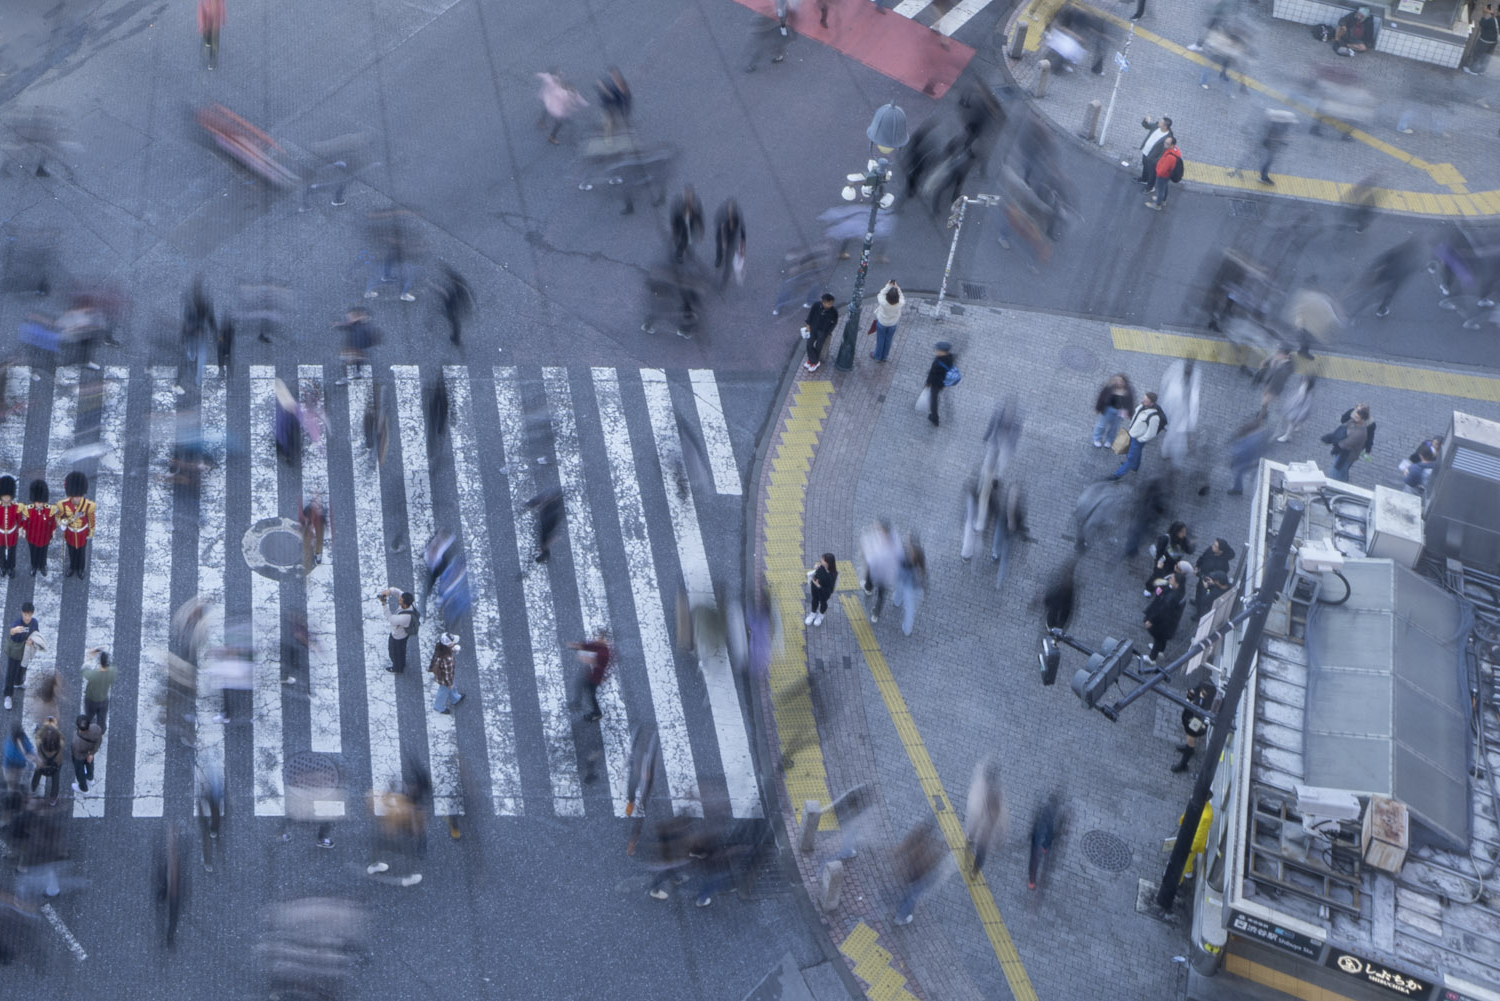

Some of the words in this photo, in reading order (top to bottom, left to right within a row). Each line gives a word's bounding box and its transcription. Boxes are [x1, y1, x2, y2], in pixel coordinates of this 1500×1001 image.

[1247, 923, 1278, 941] 渋谷駅
[1278, 938, 1302, 952] Shibuya
[1365, 963, 1422, 991] しぶちか
[1368, 975, 1410, 995] SHIBUCHIKA
